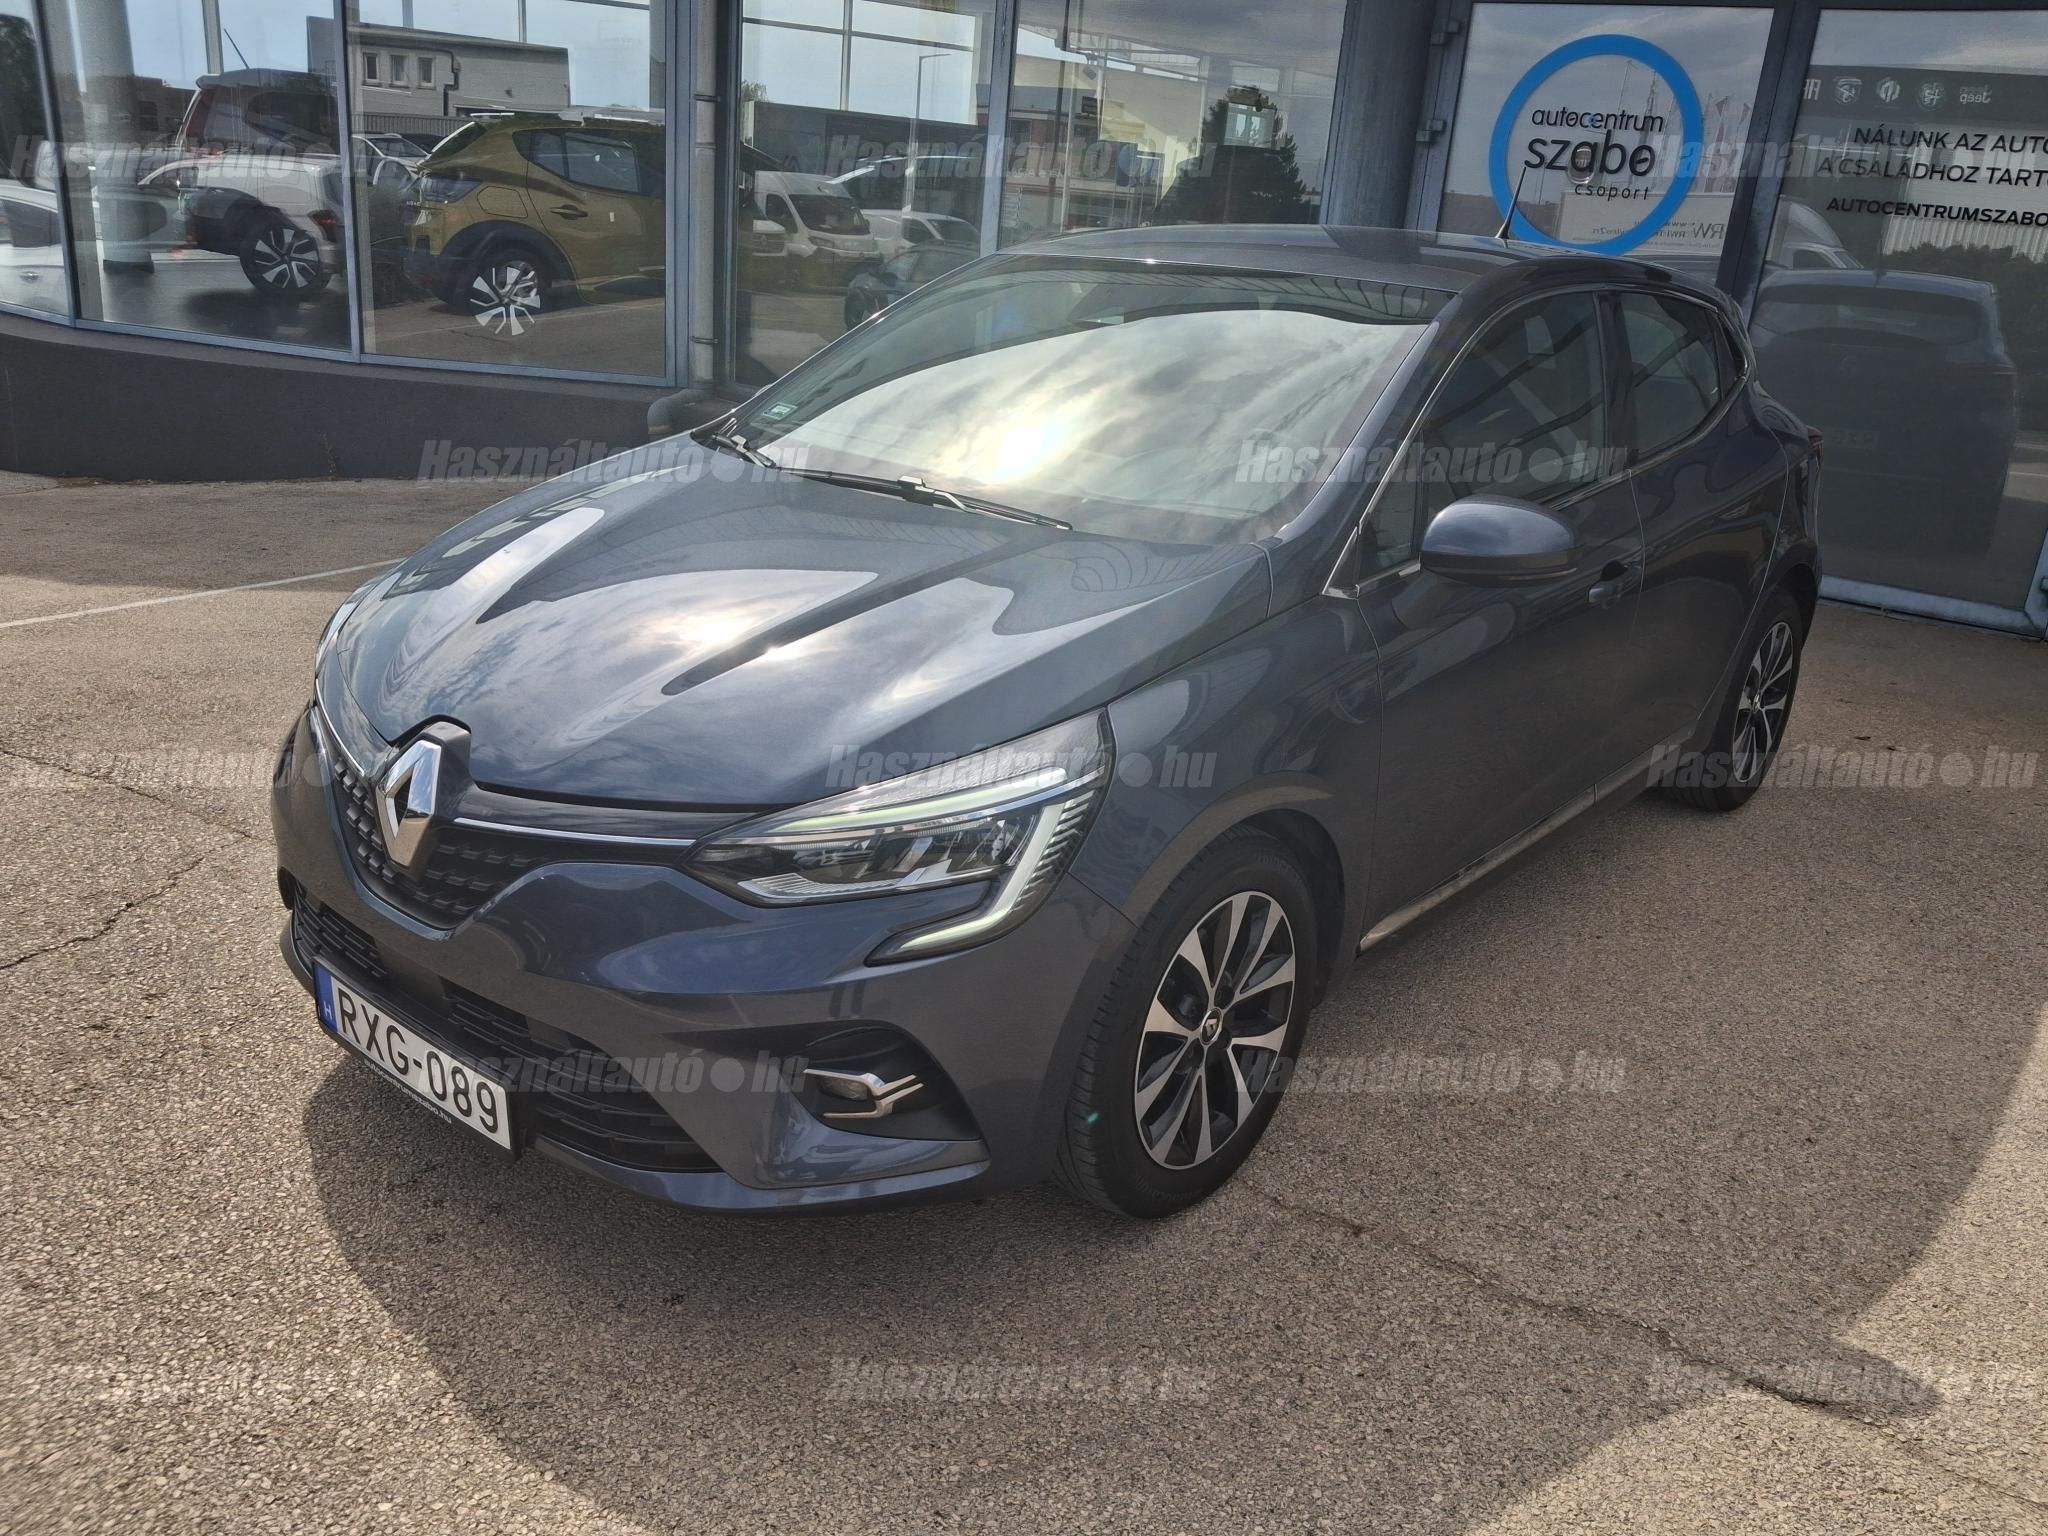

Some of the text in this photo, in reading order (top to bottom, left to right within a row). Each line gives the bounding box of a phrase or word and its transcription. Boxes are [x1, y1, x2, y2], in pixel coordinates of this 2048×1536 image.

[1531, 107, 1664, 132] autocentrum
[1854, 123, 1950, 150] NÁLUNK
[1954, 133, 1988, 151] AZ
[1818, 154, 2048, 187] A CSALÁDHOZ TART
[1575, 184, 1649, 201] csoport
[324, 1001, 333, 1020] H
[337, 987, 499, 1134] RXG-089
